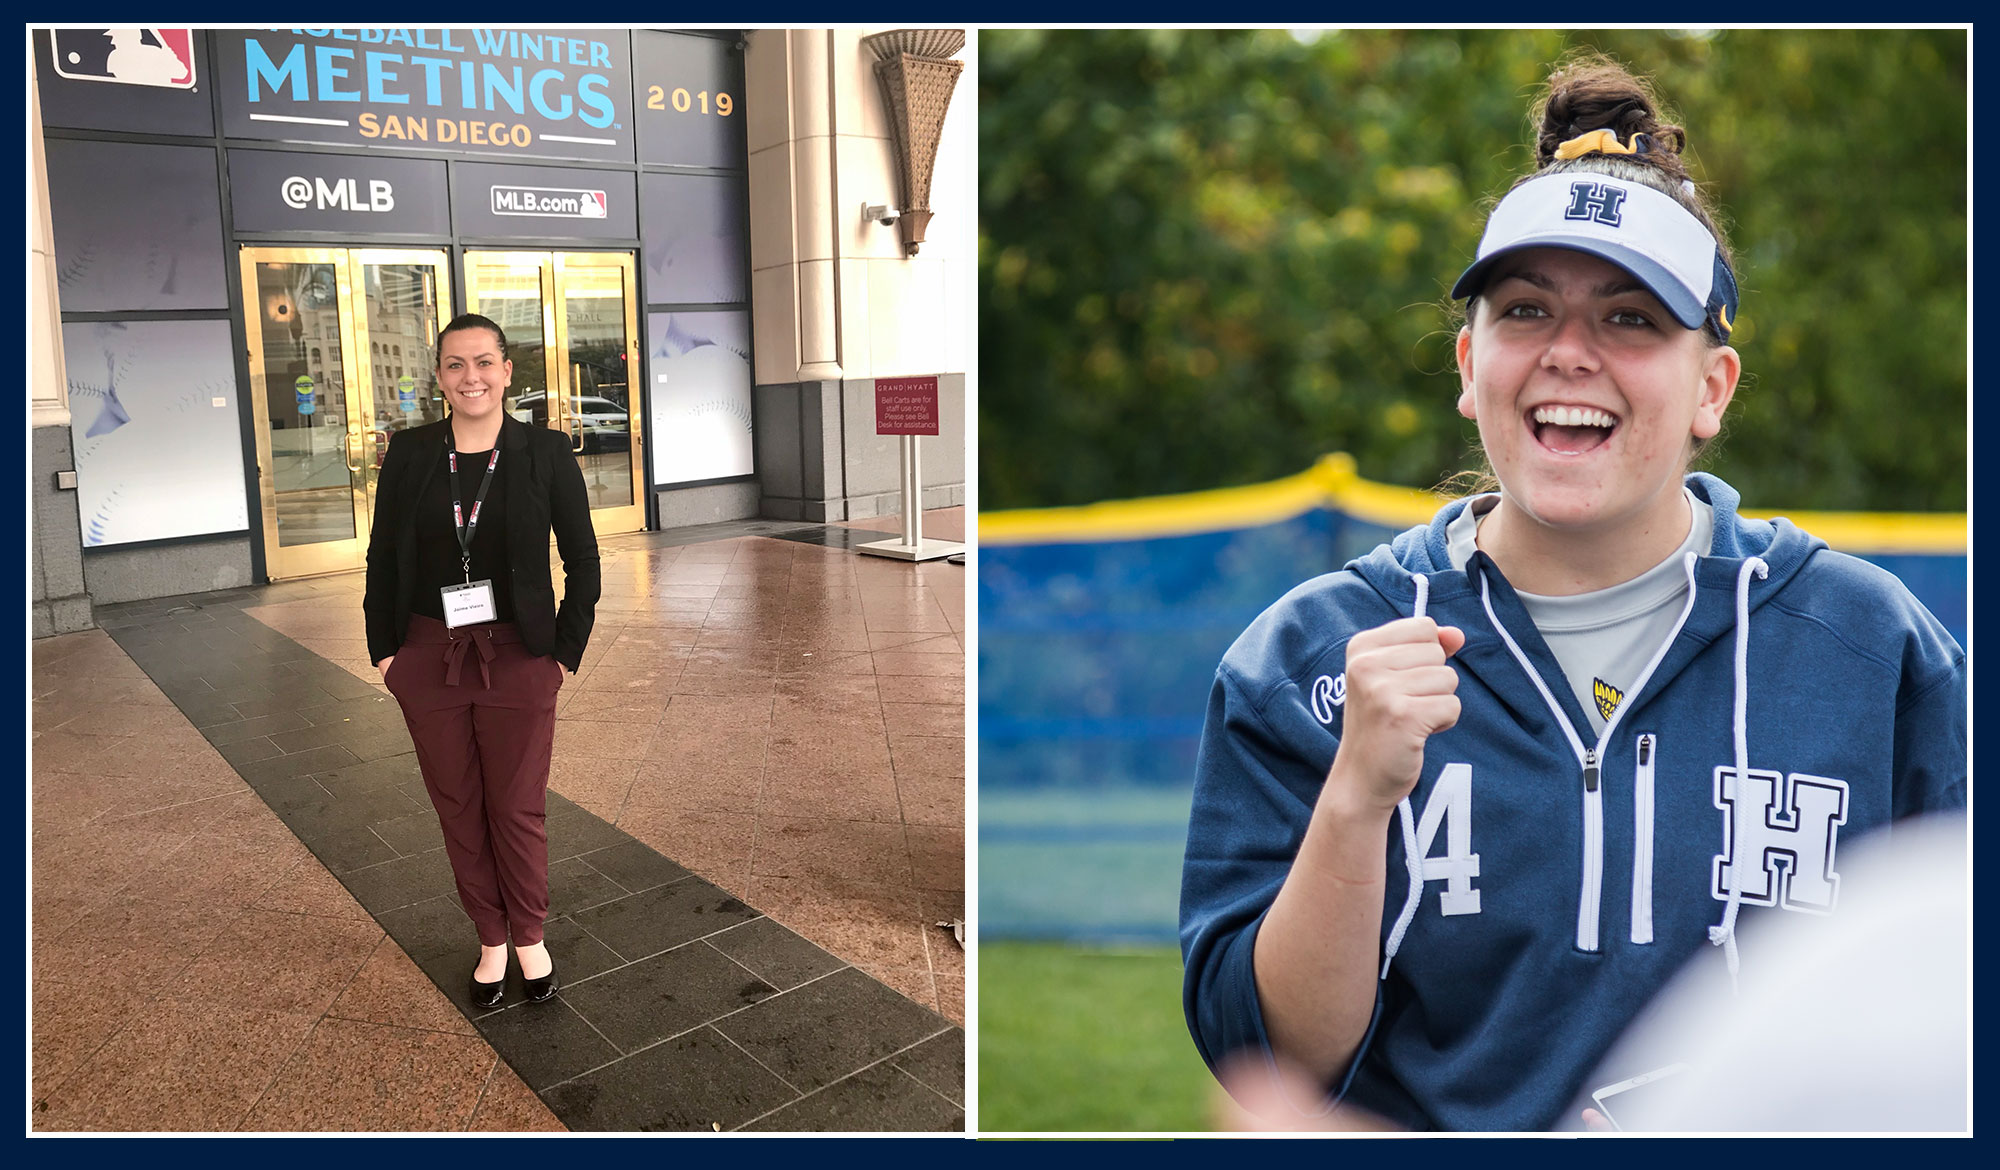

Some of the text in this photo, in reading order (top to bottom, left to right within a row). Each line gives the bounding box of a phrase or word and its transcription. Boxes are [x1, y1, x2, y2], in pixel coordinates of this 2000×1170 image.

[471, 29, 613, 69] WINTER
[245, 38, 615, 129] MEETINGS
[647, 85, 733, 117] 2019
[358, 113, 532, 148] SAN DIEGO
[281, 176, 395, 212] @MLB
[496, 191, 578, 213] MLB.com
[1565, 181, 1627, 228] H
[877, 383, 934, 392] GRAND HYATT
[881, 396, 893, 404] Bell
[893, 396, 910, 404] Carts
[922, 395, 932, 403] for
[1311, 672, 1347, 724] Ra
[1406, 762, 1482, 917] 4
[1711, 765, 1850, 916] H
